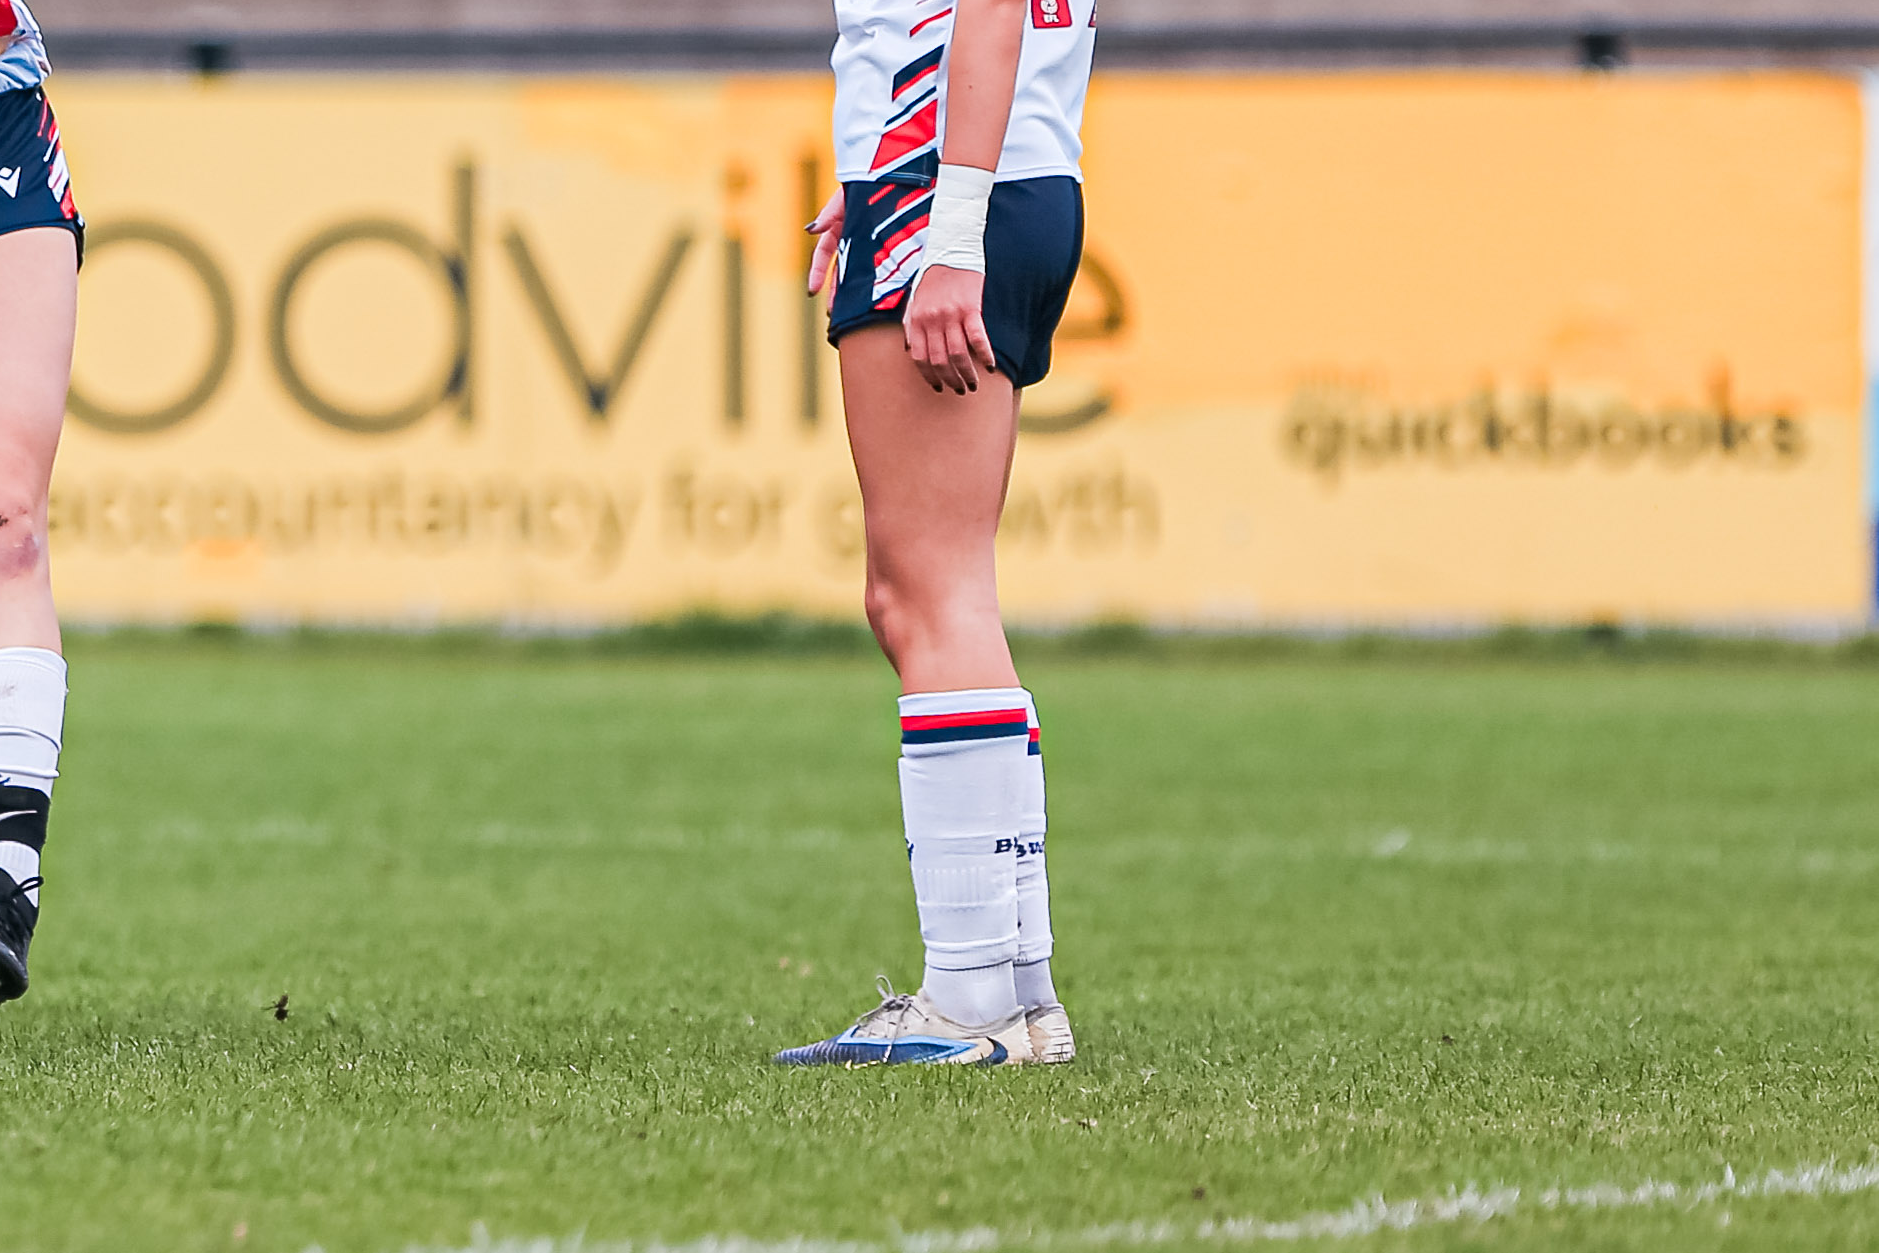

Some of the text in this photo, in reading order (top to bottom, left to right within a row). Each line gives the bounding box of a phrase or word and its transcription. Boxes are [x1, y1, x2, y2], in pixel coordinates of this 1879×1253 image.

[1280, 360, 1806, 483] quickbooks
[661, 463, 784, 545] for
[814, 460, 1164, 576] gwth
